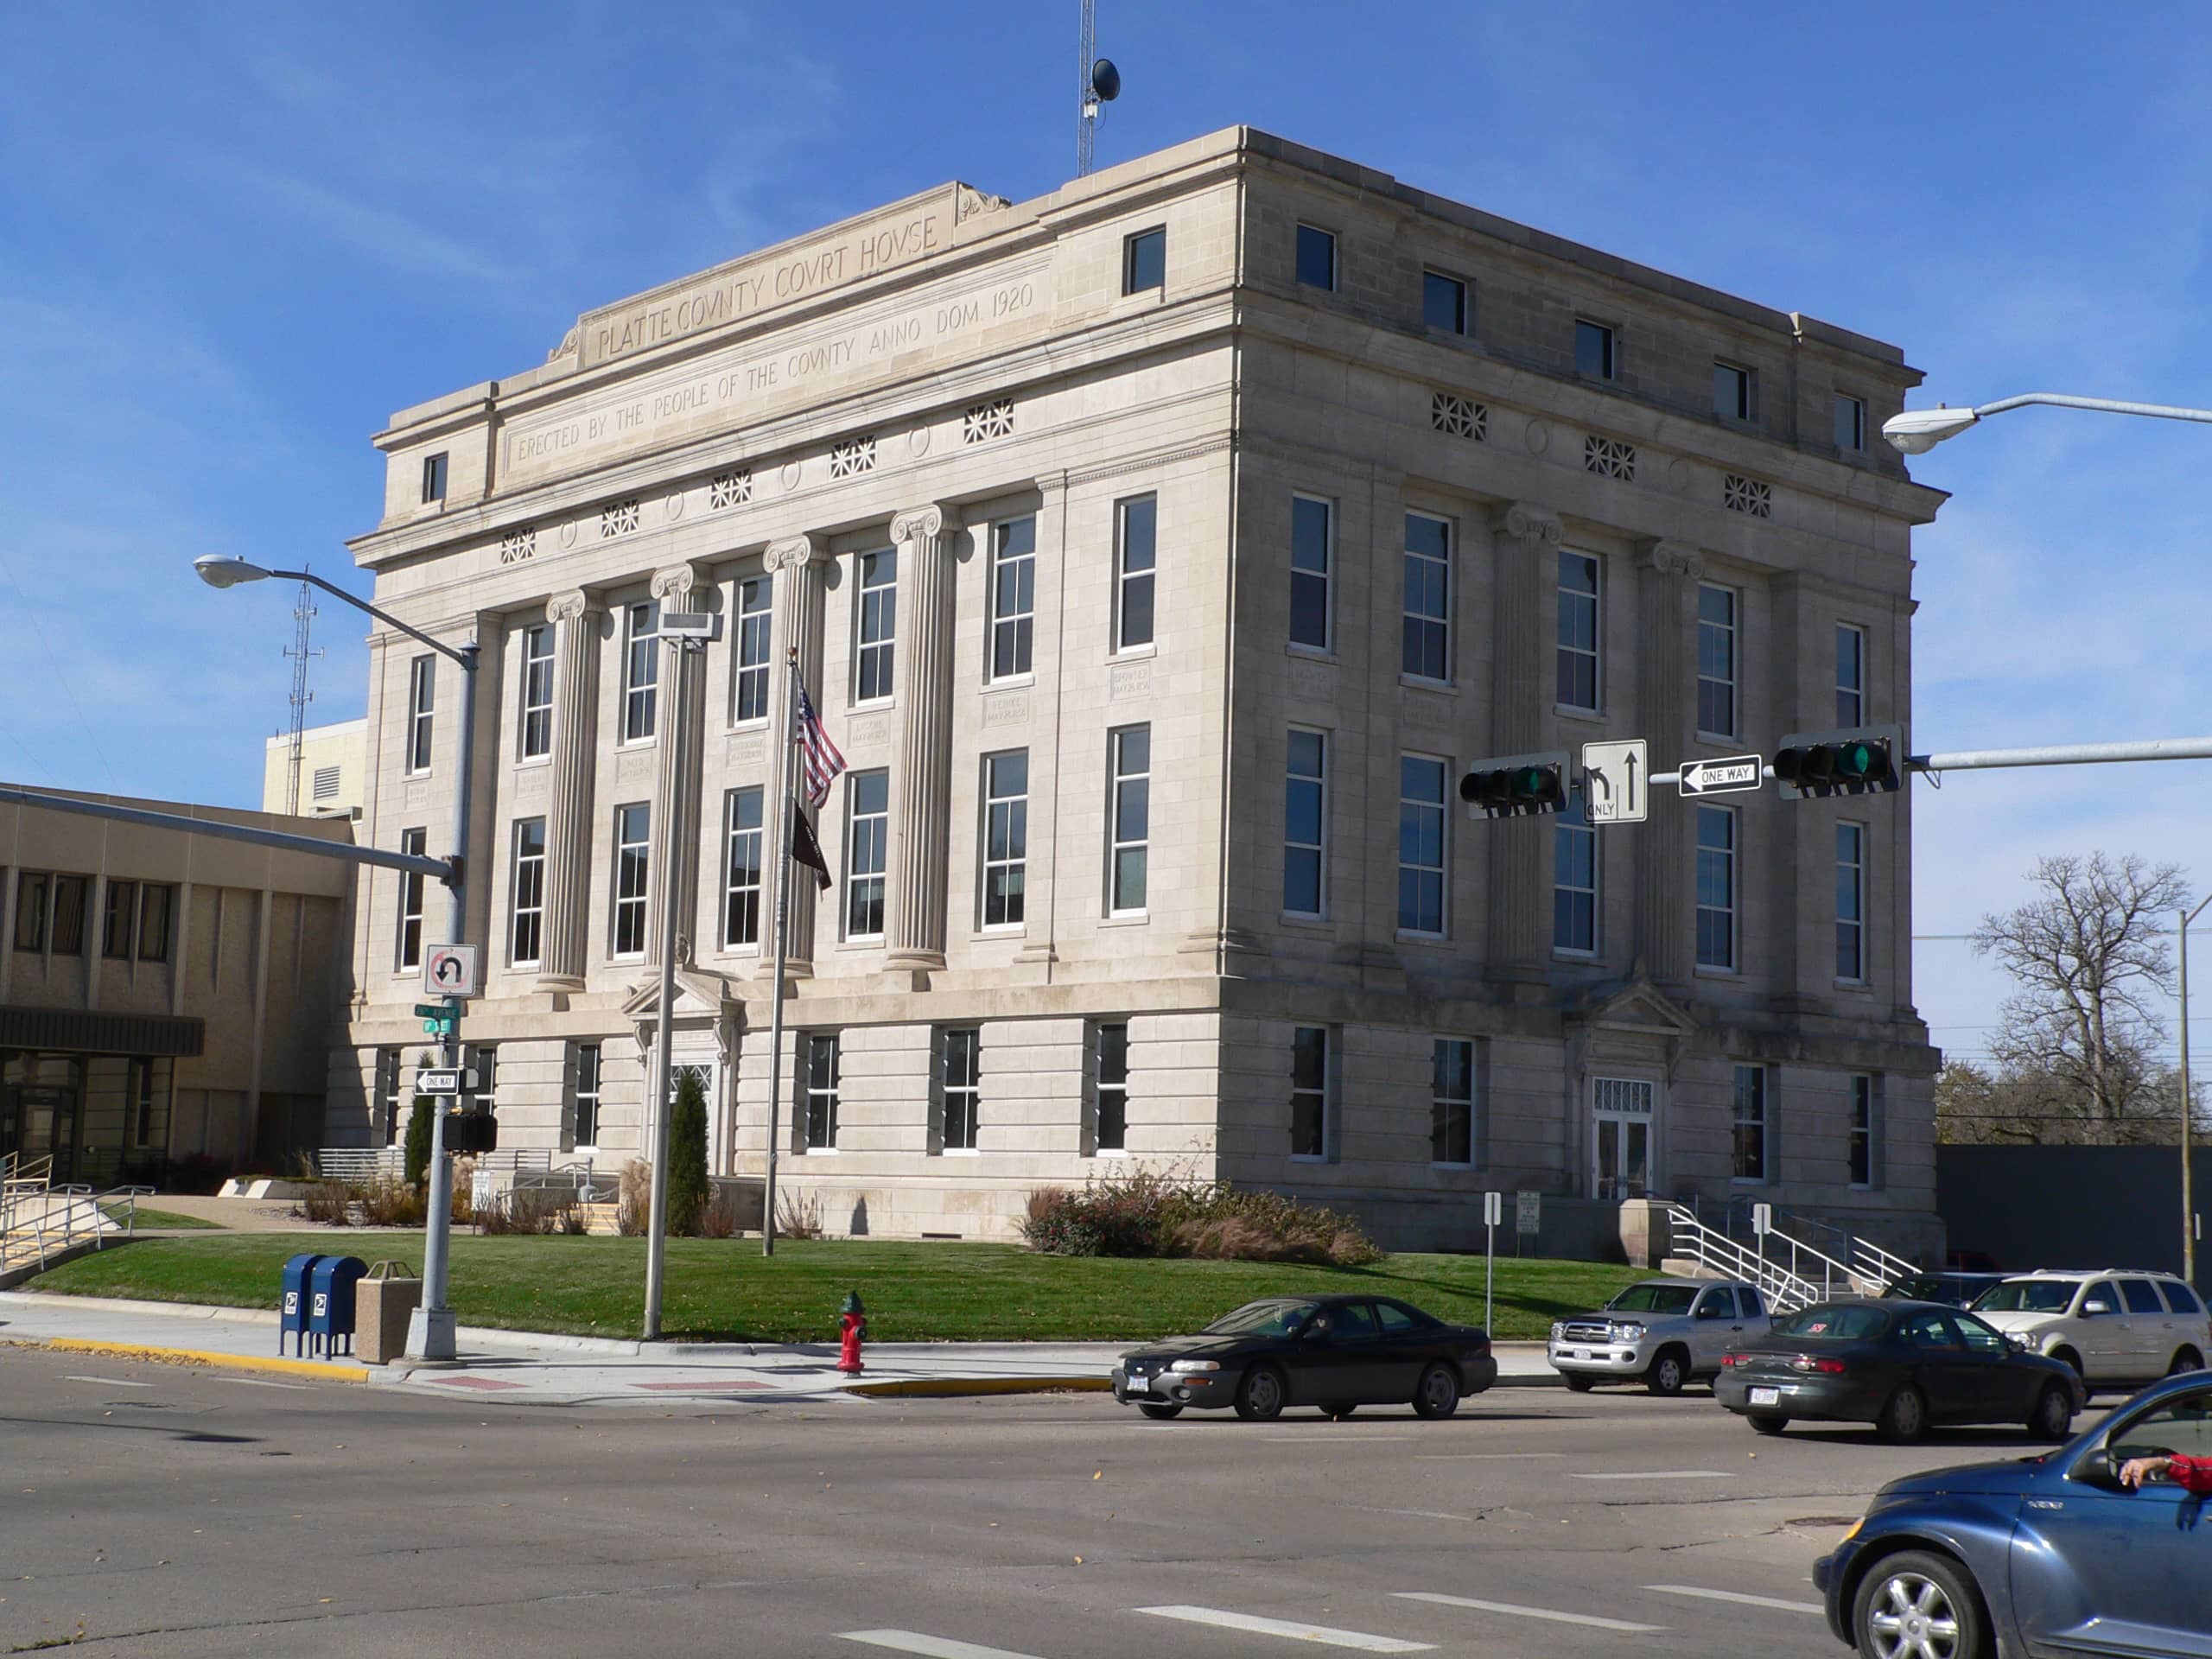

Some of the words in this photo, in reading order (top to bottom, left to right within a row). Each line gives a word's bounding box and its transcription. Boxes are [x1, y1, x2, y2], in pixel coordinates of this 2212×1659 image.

[599, 308, 672, 359] PLATTE
[678, 275, 766, 330] COVNTY
[776, 246, 848, 297] COVRT
[861, 216, 938, 270] HOVSE
[518, 424, 579, 461] ERECTED
[589, 415, 607, 439] BY
[616, 403, 643, 431] THE
[654, 383, 709, 419] PEOPLE
[718, 374, 738, 399] OF
[747, 362, 778, 390] THE
[869, 318, 920, 353] ANNO
[993, 283, 1033, 317] 1920
[1702, 769, 1724, 784] ONE
[1727, 766, 1750, 780] WAY
[1587, 804, 1615, 817] ONLY
[427, 1077, 438, 1086] ONE
[440, 1077, 453, 1086] WAY
